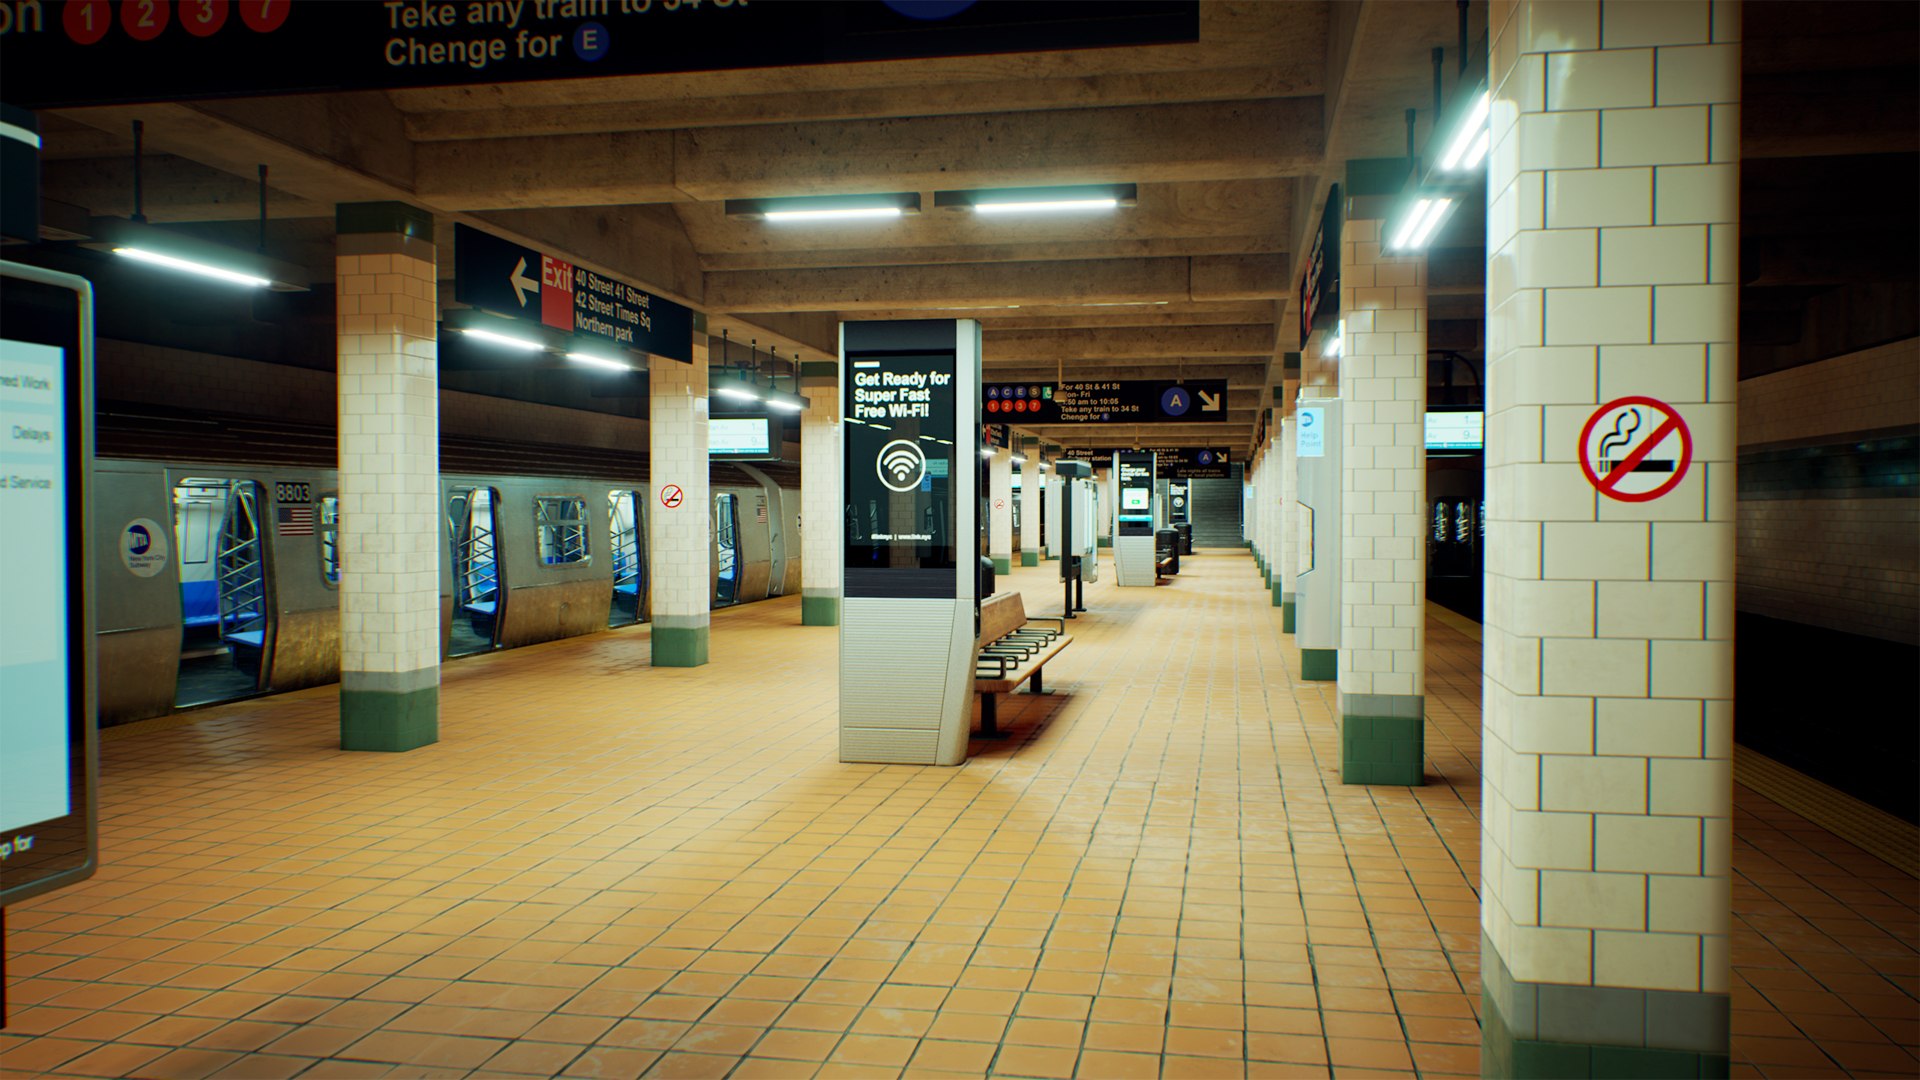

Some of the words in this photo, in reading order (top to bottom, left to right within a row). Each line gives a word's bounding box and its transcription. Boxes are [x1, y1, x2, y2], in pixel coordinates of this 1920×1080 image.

[79, 2, 93, 32] 1
[137, 0, 155, 28] 2
[195, 0, 214, 24] 3
[385, 1, 457, 29] Teke
[466, 0, 526, 28] any
[384, 36, 507, 69] Chenge
[516, 29, 563, 59] for
[582, 29, 599, 51] E
[541, 255, 573, 293] Exit
[575, 269, 587, 287] 40
[587, 272, 614, 297] Street
[615, 282, 625, 301] 41
[626, 286, 650, 310] Street
[575, 290, 587, 309] 42
[587, 293, 614, 317] Street
[615, 302, 639, 325] Times
[640, 311, 651, 332] Sq
[575, 310, 614, 337] Northern
[615, 326, 634, 343] park
[854, 371, 880, 387] Get
[882, 370, 928, 389] Ready
[929, 370, 951, 386] for
[1074, 383, 1084, 391] 40
[1112, 382, 1121, 390] St
[854, 387, 898, 406] Super
[899, 387, 931, 402] Fast
[1169, 394, 1183, 407] A
[854, 403, 887, 418] Free
[888, 402, 930, 418] Wi-Fi!
[1079, 406, 1093, 414] any
[1089, 412, 1101, 420] for
[12, 425, 52, 443] Delays
[10, 475, 52, 488] Service
[276, 484, 310, 502] 8803
